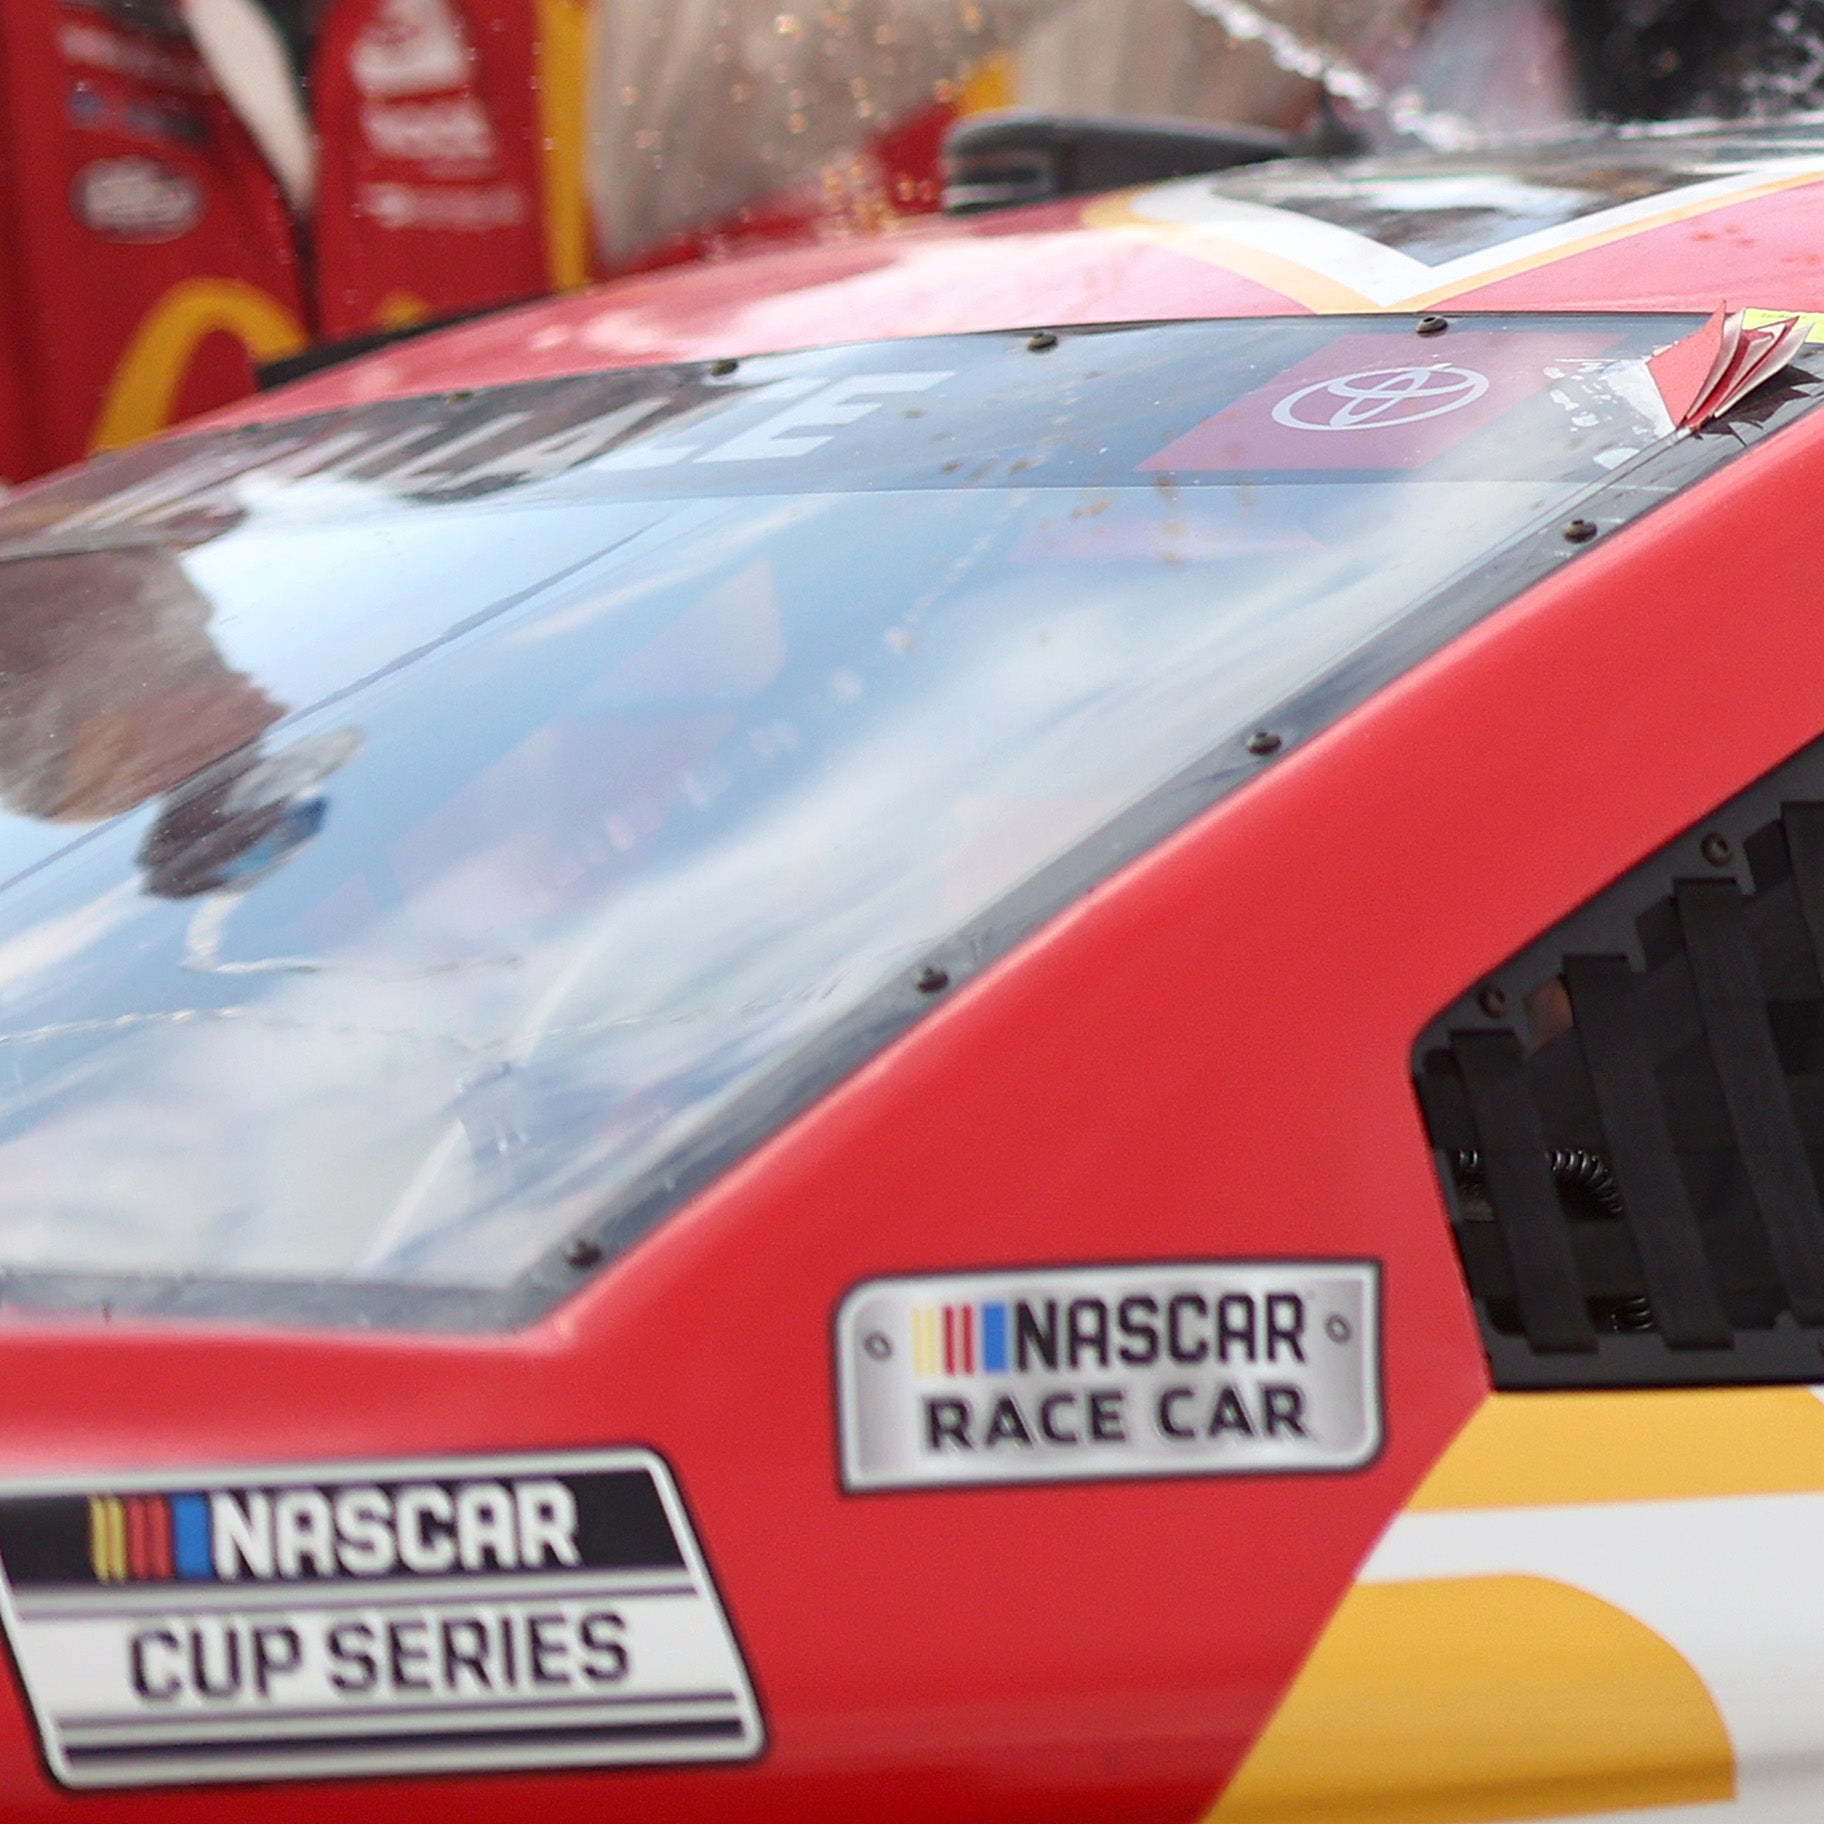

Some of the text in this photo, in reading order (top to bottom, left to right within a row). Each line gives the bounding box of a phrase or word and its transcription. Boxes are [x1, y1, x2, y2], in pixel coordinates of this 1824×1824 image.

[1015, 1292, 1307, 1373] NASCAR
[924, 1382, 1308, 1453] RACE CAR
[211, 1478, 583, 1580] NASCAR
[128, 1611, 630, 1702] CUP SERIES
